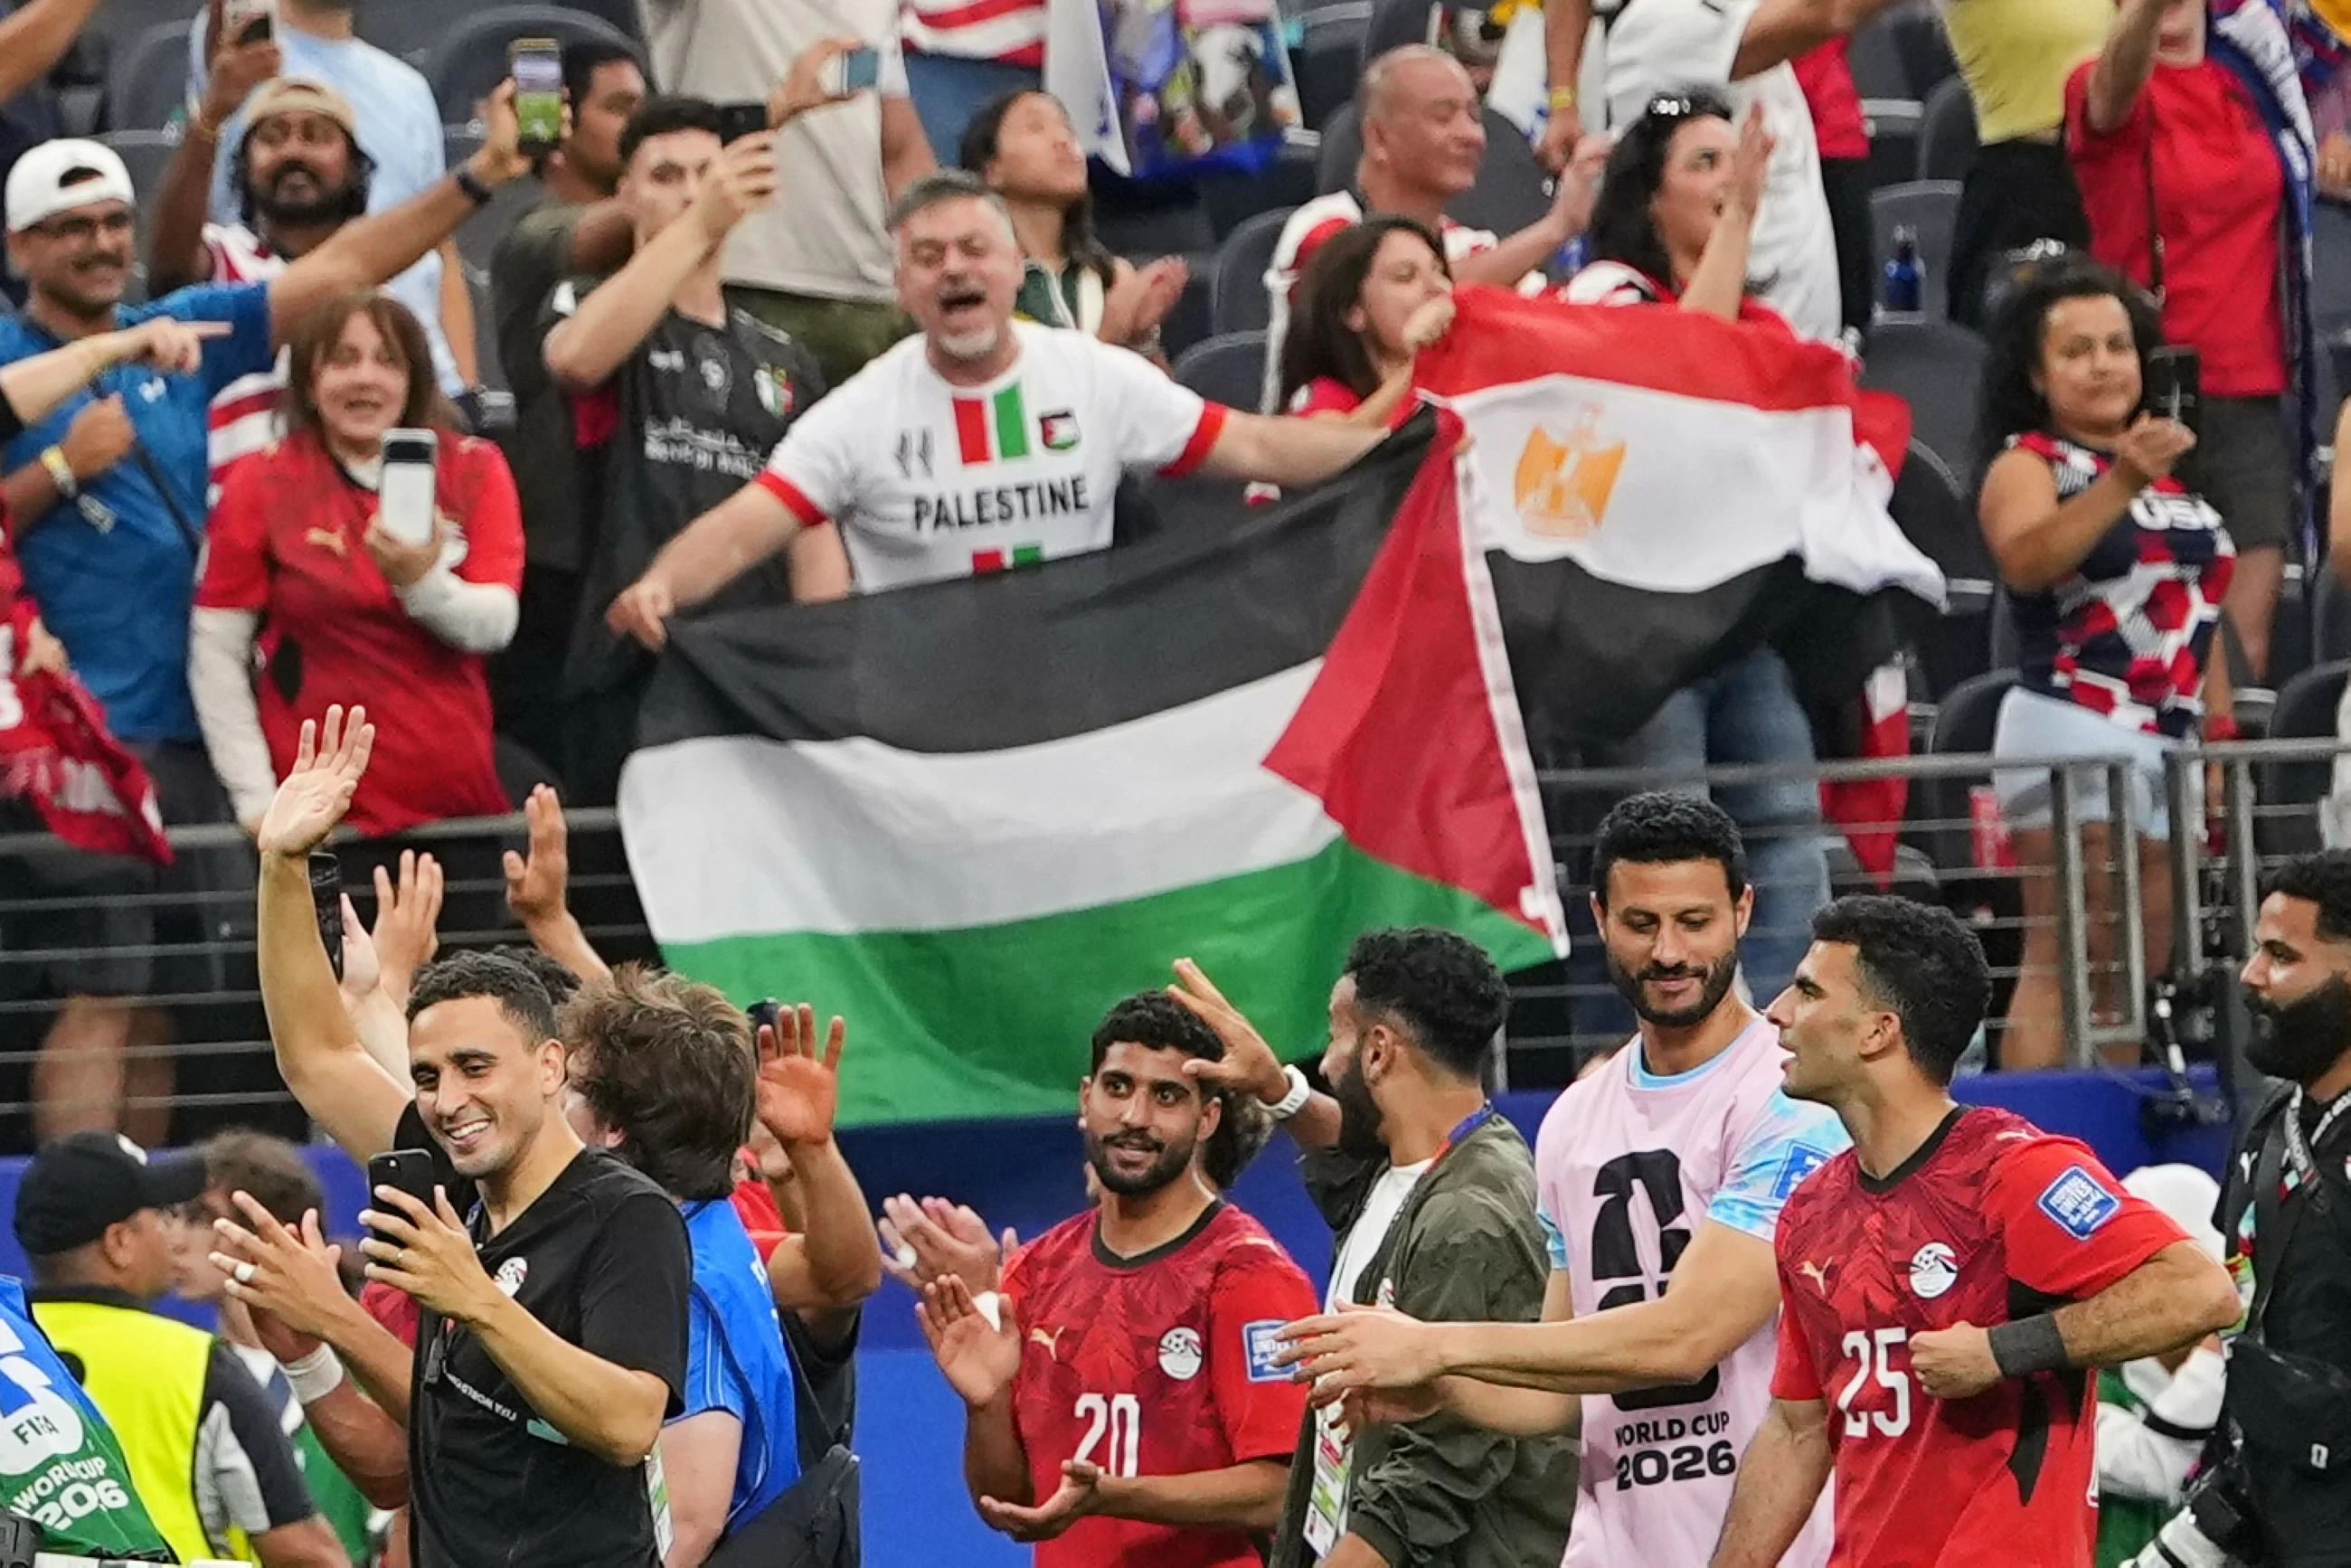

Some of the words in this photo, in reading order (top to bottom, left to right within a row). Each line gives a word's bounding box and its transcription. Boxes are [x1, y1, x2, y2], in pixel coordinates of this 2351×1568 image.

[914, 475, 1090, 531] PALESTINE
[1836, 1327, 1911, 1438] 25
[1074, 1393, 1140, 1478] 20
[1691, 1411, 1730, 1436] CUP
[12, 1460, 78, 1512] WORL
[74, 1456, 107, 1480] CUP
[1617, 1440, 1736, 1491] 2026
[33, 1478, 129, 1531] 206
